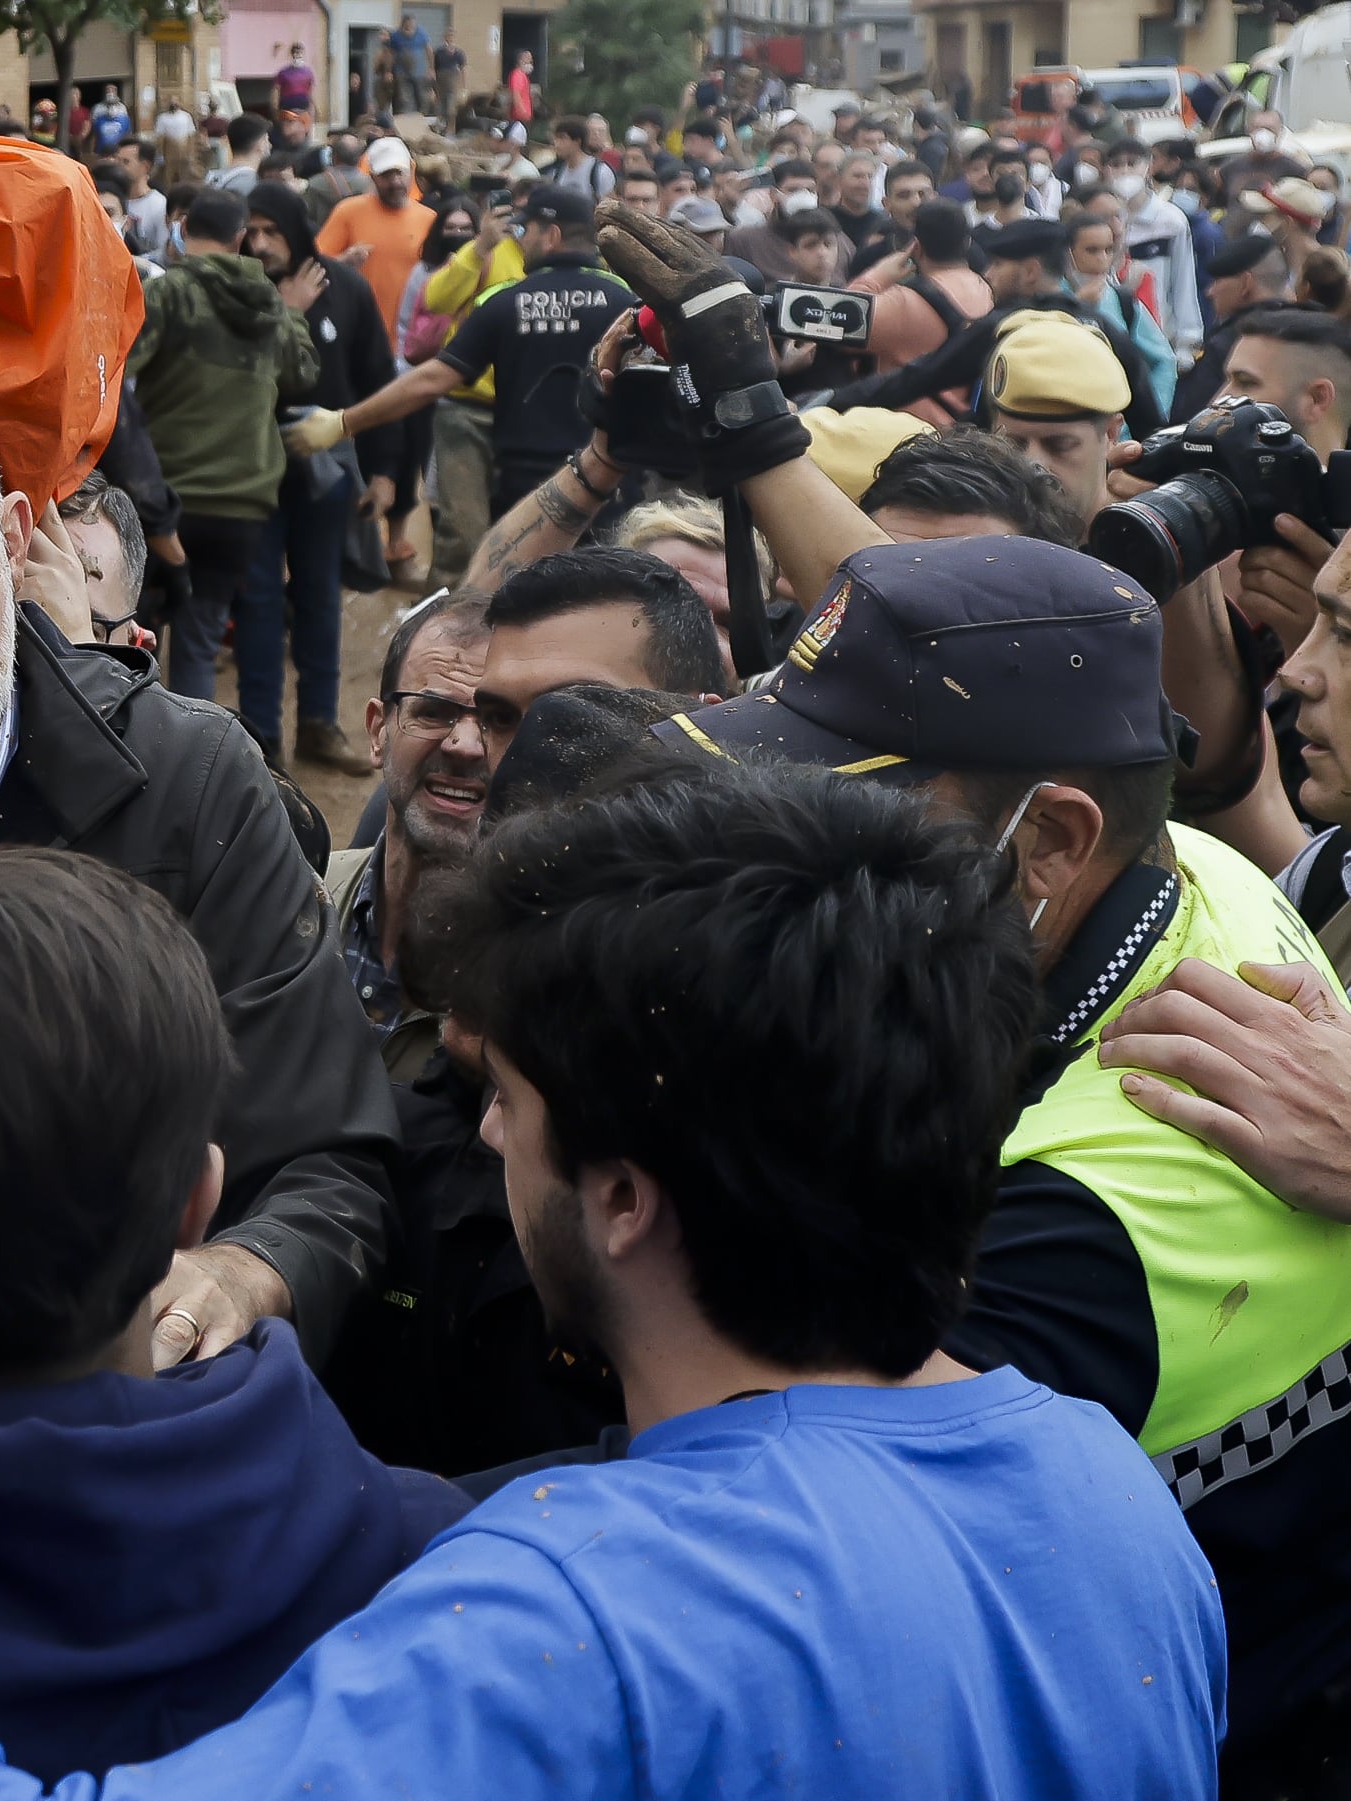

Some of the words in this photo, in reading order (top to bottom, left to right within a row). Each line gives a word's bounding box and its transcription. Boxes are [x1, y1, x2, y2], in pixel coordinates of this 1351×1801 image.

[516, 290, 608, 308] POLICIA
[1183, 442, 1213, 453] Canon
[1258, 455, 1276, 464] EOS
